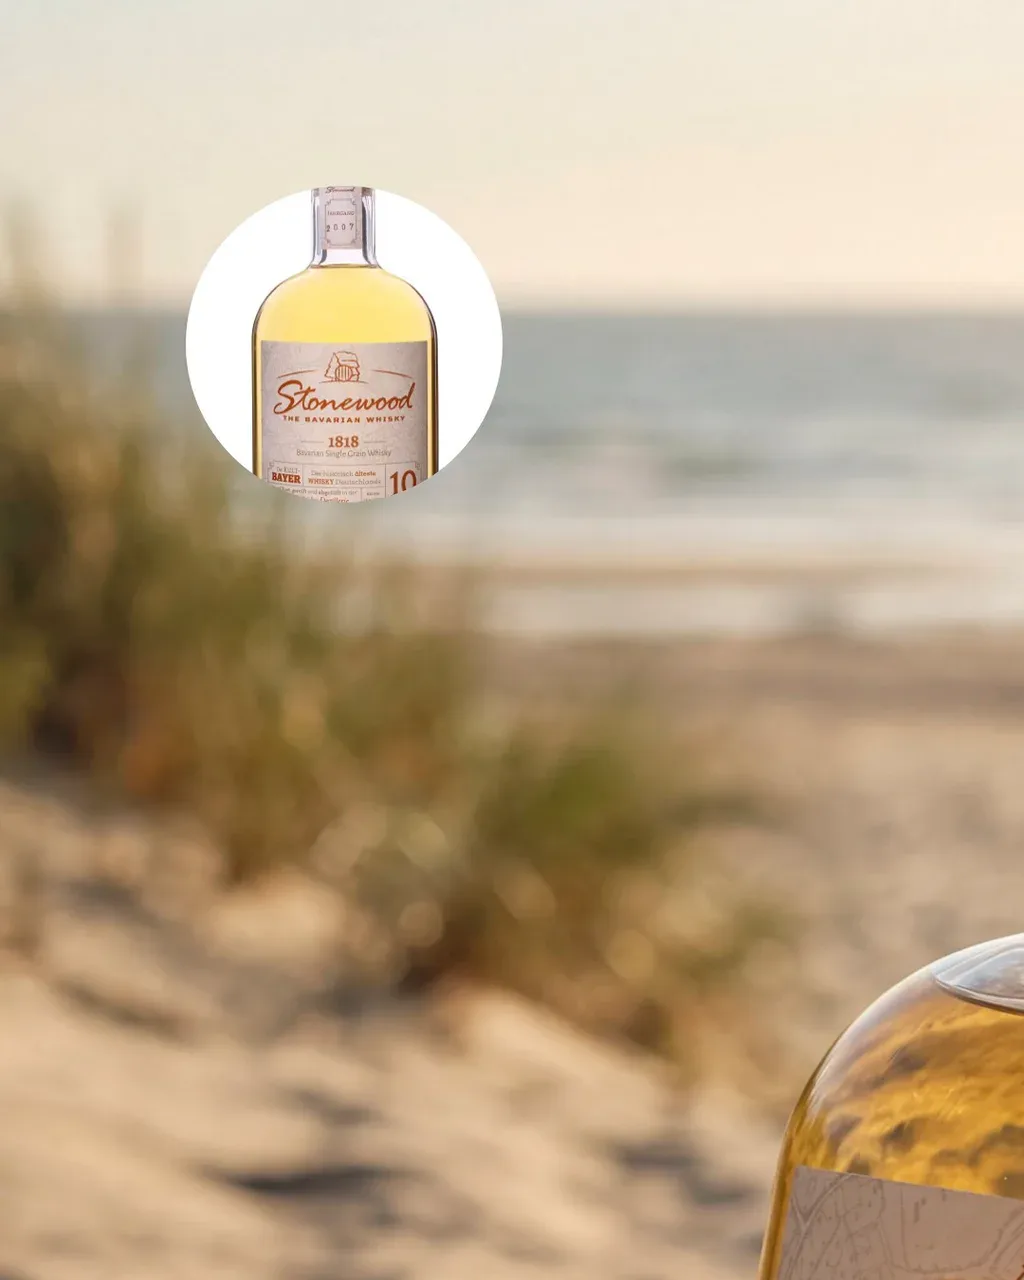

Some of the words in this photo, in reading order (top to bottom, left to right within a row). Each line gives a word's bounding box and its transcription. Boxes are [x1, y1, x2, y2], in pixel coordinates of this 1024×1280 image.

[326, 222, 354, 232] 2007
[273, 379, 416, 415] Stonewood
[366, 415, 406, 423] WHISKY
[328, 435, 359, 448] 1818
[296, 449, 324, 457] Bavarian
[325, 450, 346, 458] Single
[271, 472, 301, 484] BAYER
